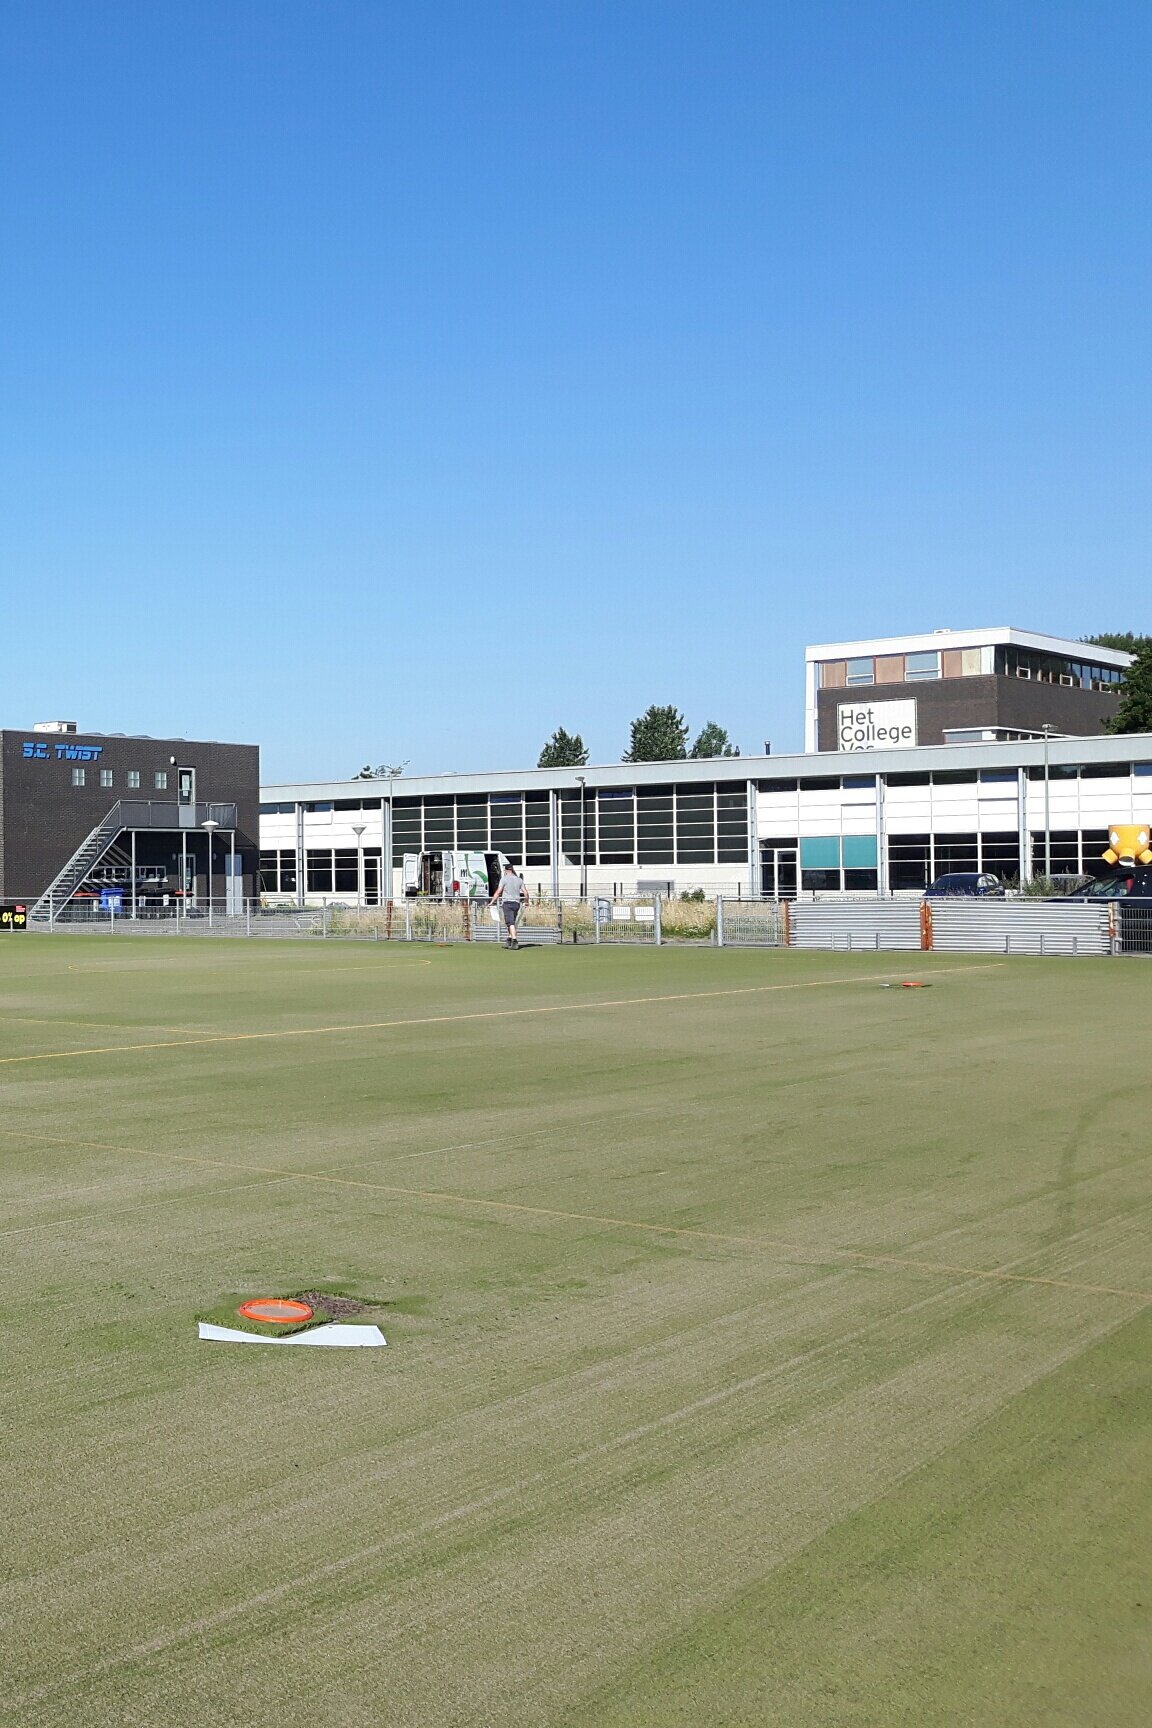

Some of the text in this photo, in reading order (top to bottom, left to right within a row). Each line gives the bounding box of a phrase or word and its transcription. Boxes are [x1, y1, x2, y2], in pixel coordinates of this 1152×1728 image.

[841, 708, 874, 726] Het
[841, 724, 912, 744] College
[54, 744, 103, 761] TWIST
[14, 914, 25, 924] op
